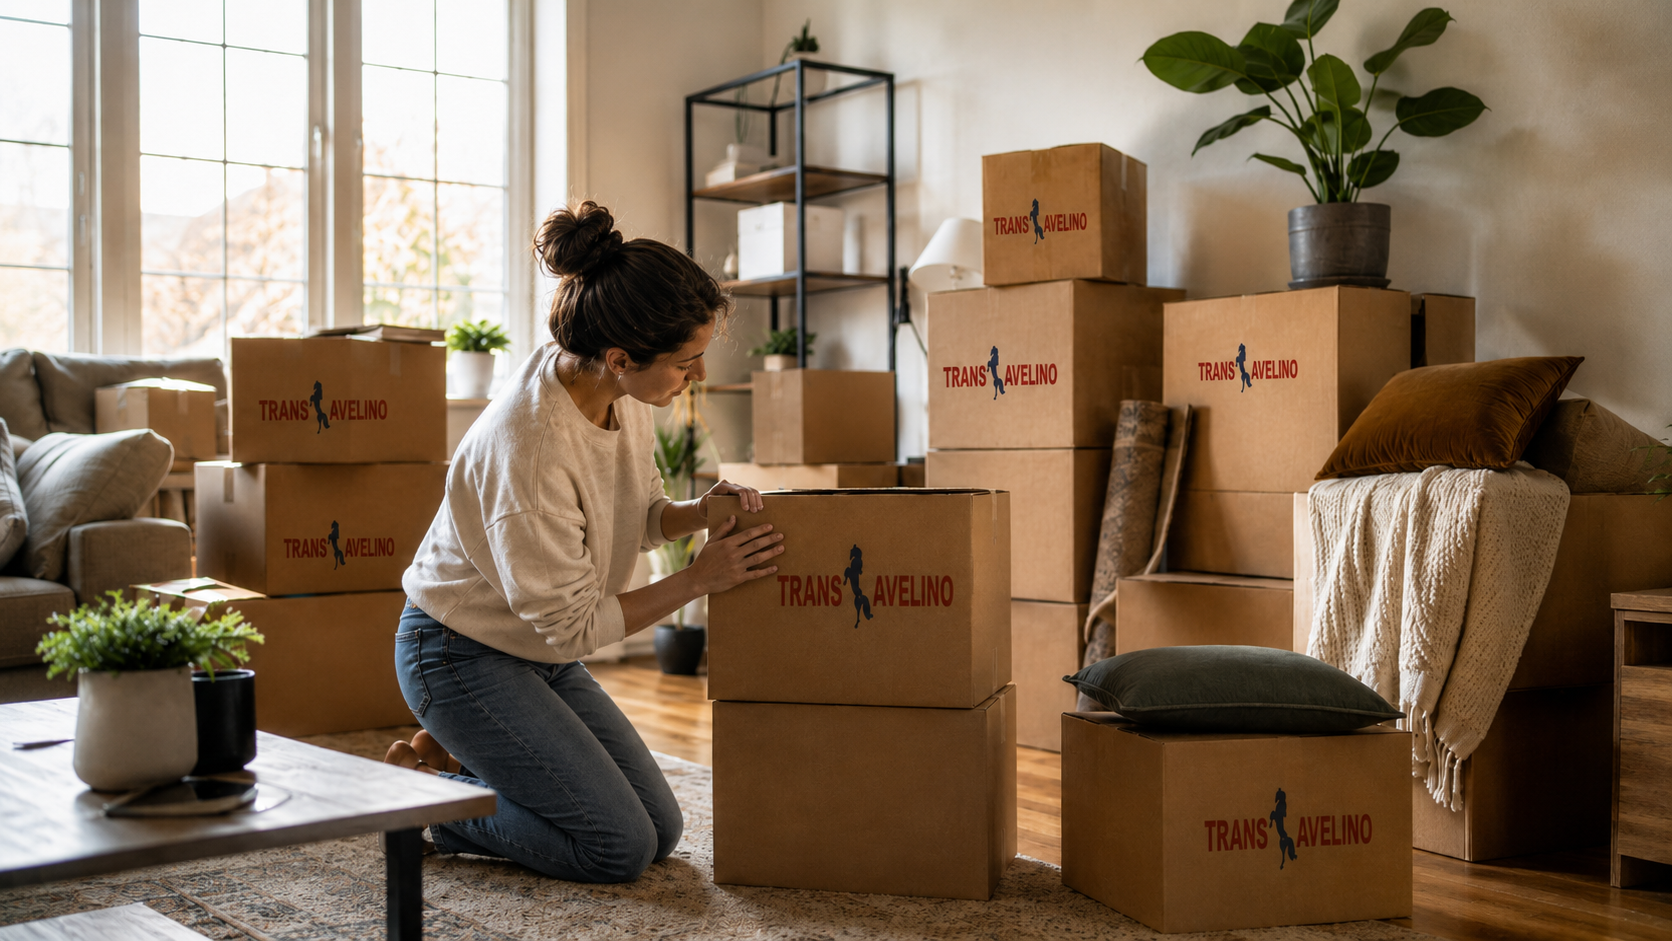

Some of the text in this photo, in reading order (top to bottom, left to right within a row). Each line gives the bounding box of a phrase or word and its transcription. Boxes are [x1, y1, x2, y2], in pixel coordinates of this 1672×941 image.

[993, 212, 1087, 235] TRANS AVELINO
[943, 363, 1058, 388] TRANS AVELINO
[1198, 359, 1298, 381] TRANS AVELINO
[258, 399, 388, 421] TRANS AVELINO
[283, 537, 395, 558] TRANS AVELINO
[777, 575, 954, 607] TRANS AVELINO
[1204, 813, 1373, 852] TRANS AVELINO
